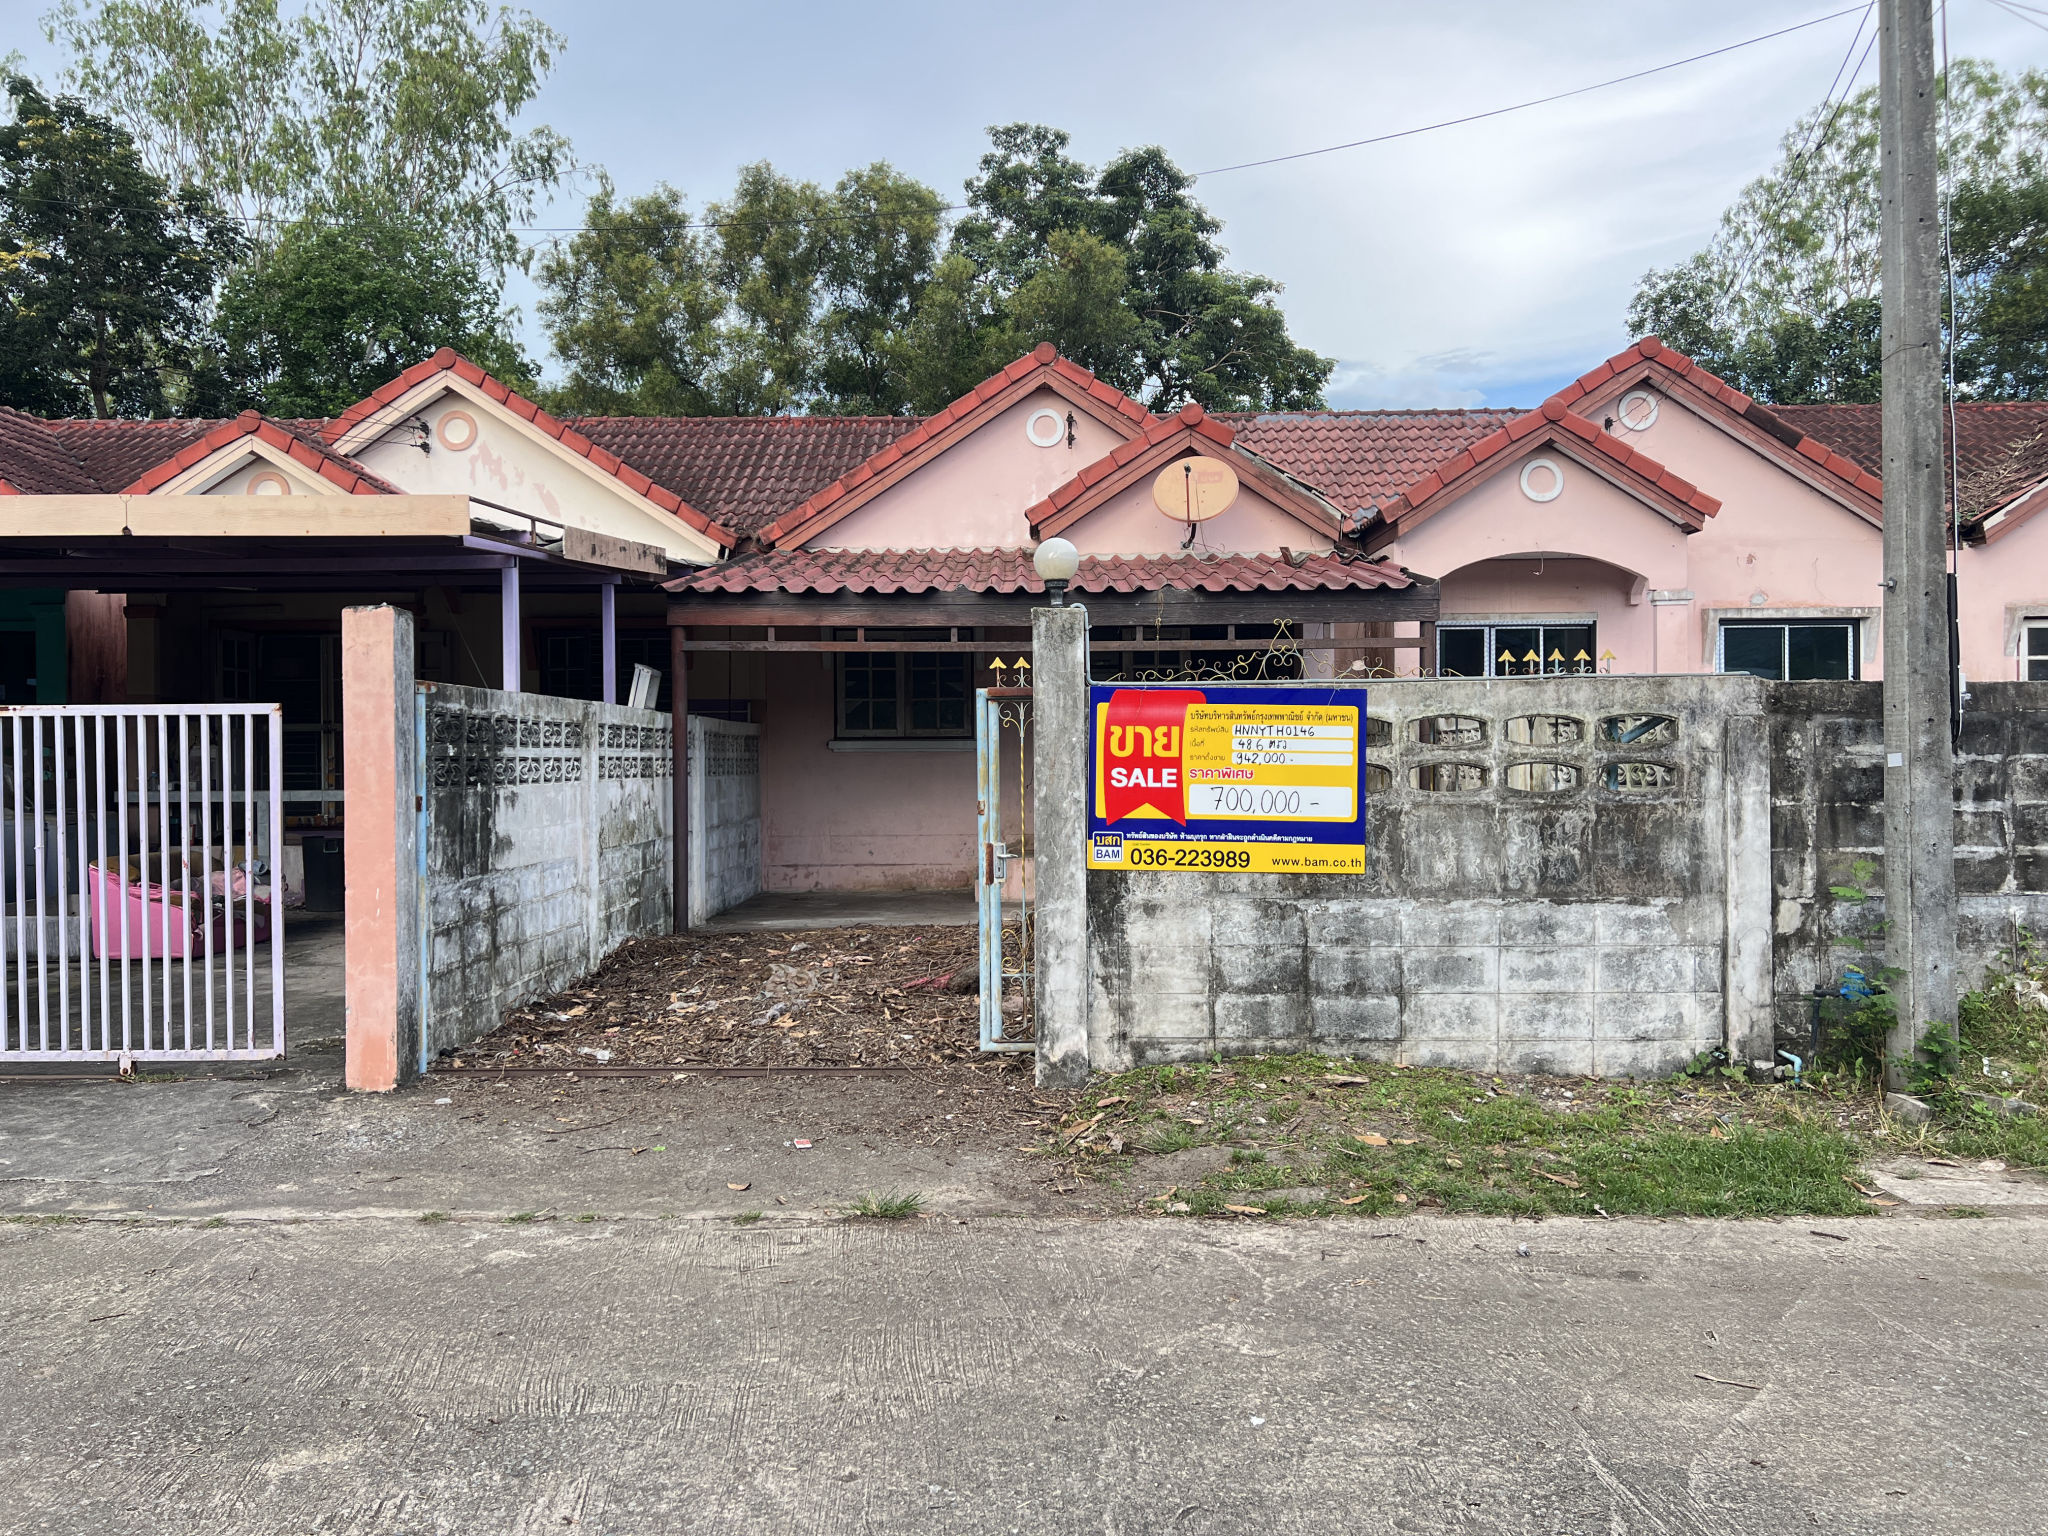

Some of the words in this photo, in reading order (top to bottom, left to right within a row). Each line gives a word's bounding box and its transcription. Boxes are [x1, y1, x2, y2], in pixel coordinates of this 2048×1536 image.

[1307, 711, 1323, 721] จำกัด
[1326, 713, 1354, 723] (มหาชน)
[1110, 725, 1180, 758] ขาย
[1110, 768, 1178, 788] SALE
[1189, 767, 1254, 779] ราคาพิเศษ
[1095, 835, 1120, 846] บสก
[1096, 849, 1120, 859] BAM
[1130, 848, 1251, 868] 036-223989
[1271, 856, 1362, 868] www.bam.co.th
